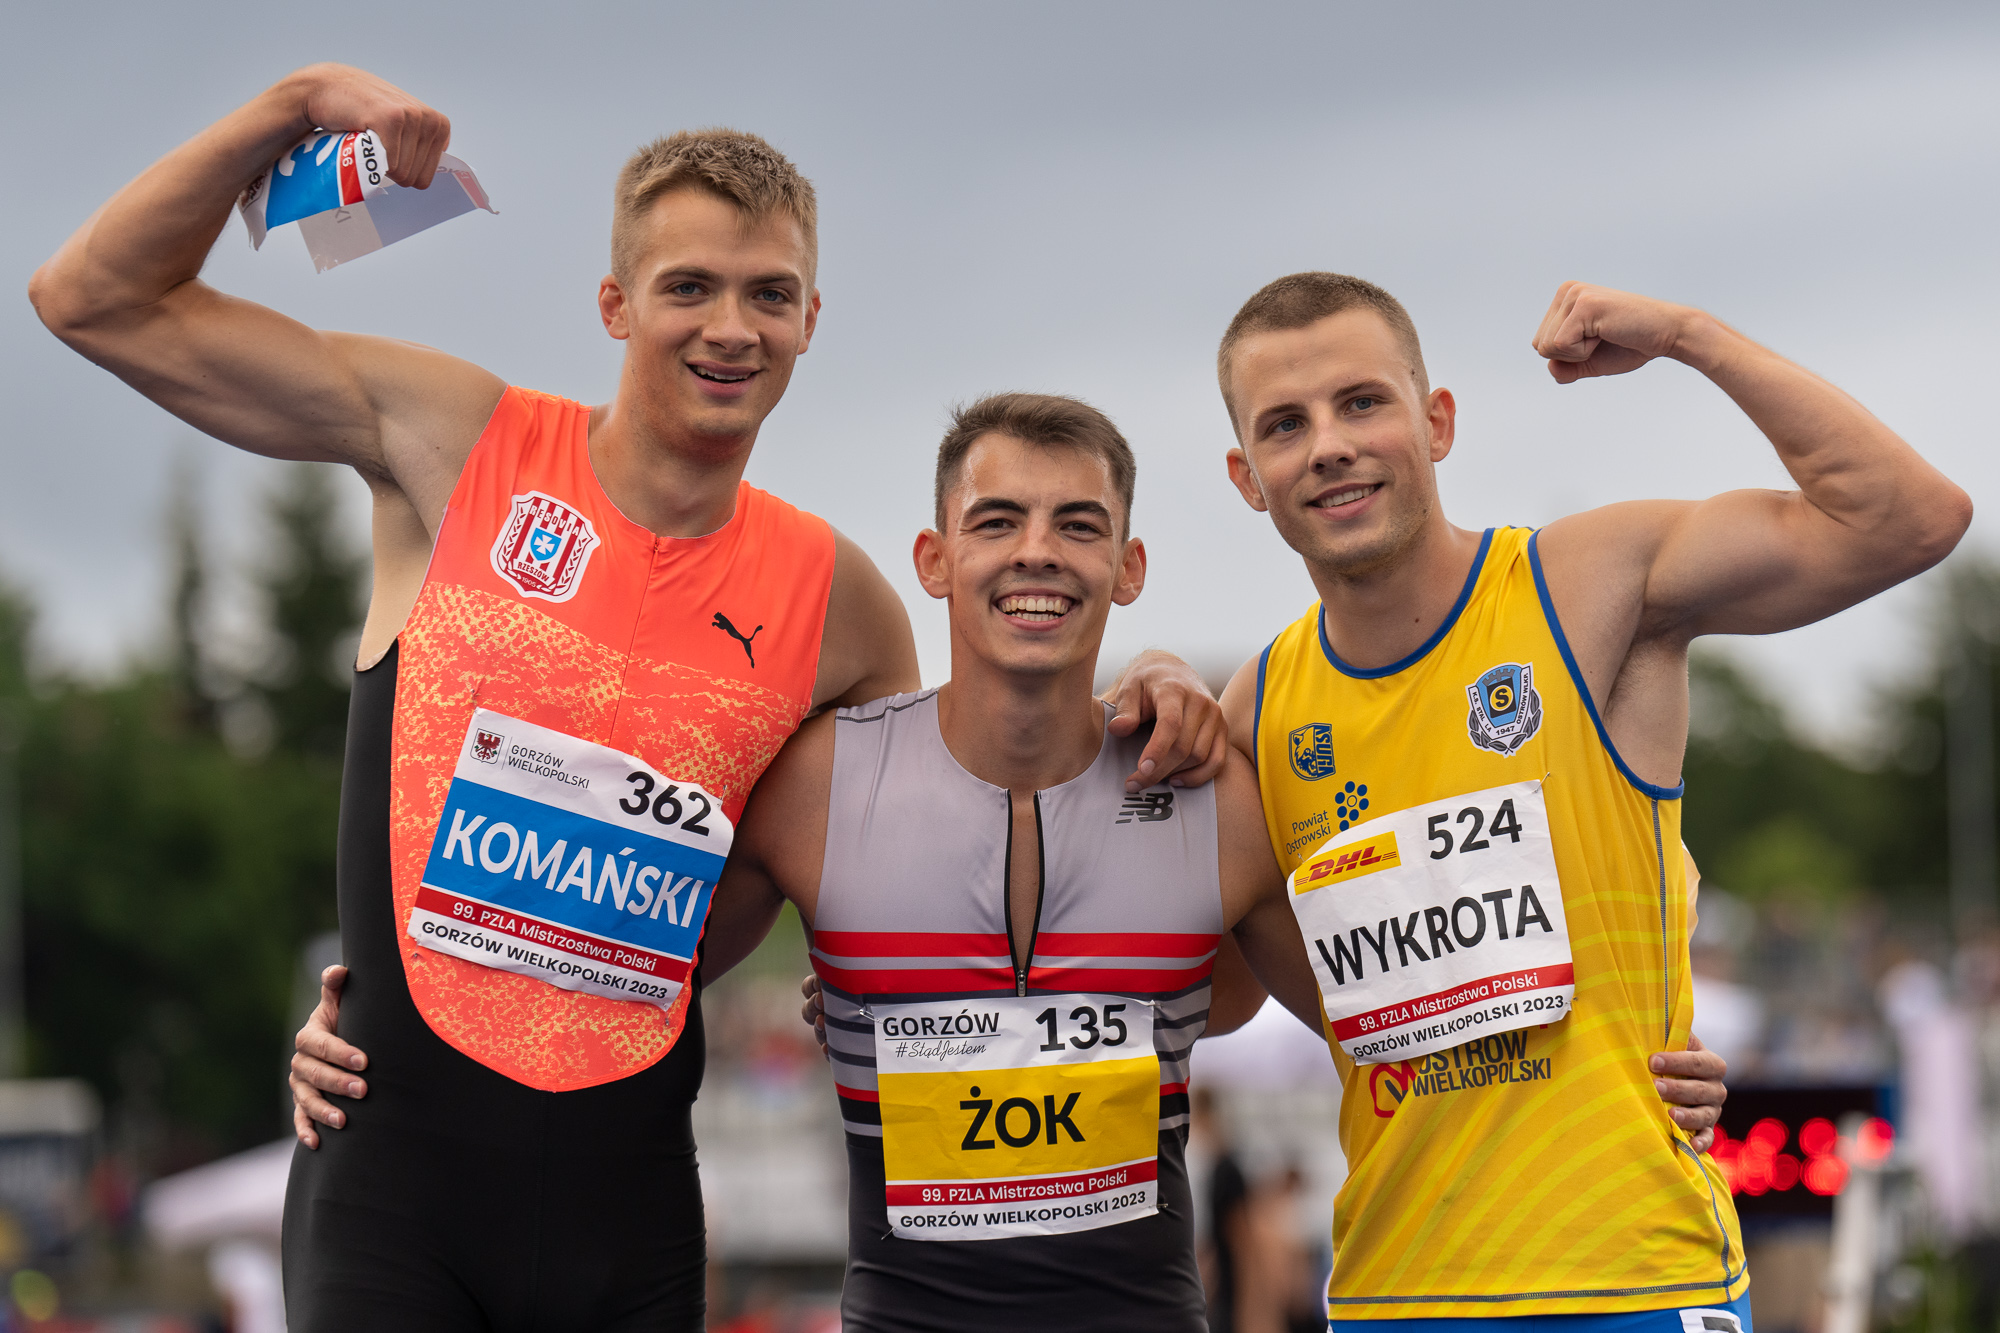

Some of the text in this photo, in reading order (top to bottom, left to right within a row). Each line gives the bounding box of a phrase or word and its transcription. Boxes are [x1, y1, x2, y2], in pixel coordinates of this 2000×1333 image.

[361, 132, 381, 186] GORZ
[529, 505, 580, 537] RESOVIA
[521, 577, 537, 588] 1905
[1476, 706, 1486, 722] STAL
[1494, 688, 1510, 708] S
[1495, 725, 1516, 736] 1947
[507, 756, 590, 789] WIELKOPOLSKI
[511, 744, 564, 769] GORZÓW
[618, 770, 712, 837] 362
[1291, 809, 1330, 835] Powiat
[1286, 822, 1332, 855] Ostrowski
[1427, 797, 1522, 861] 524
[442, 808, 705, 929] KOMAŃSKI
[1308, 845, 1383, 883] DHL
[452, 902, 658, 972] 99. PZLA Mistrzostwa Polski
[1314, 884, 1554, 987] WYKROTA
[422, 921, 668, 999] GORZÓW WIELKOPOLSKI 2023
[1358, 972, 1539, 1032] 99. PZLA Mistrzostwa Polski
[883, 1008, 1000, 1036] GORZÓW
[1035, 1003, 1128, 1052] 135
[1353, 995, 1564, 1058] GORZÓW WIELKOPOLSKI 2023
[895, 1040, 987, 1061] #StądJestem
[1413, 1058, 1551, 1097] WIELKOPOLSKI
[959, 1085, 1086, 1151] ŻOK
[921, 1170, 1127, 1202] 99. PZLA Mistrzostwa Polski
[900, 1191, 1146, 1228] GORZÓW WIELKOPOLSKI 2023
